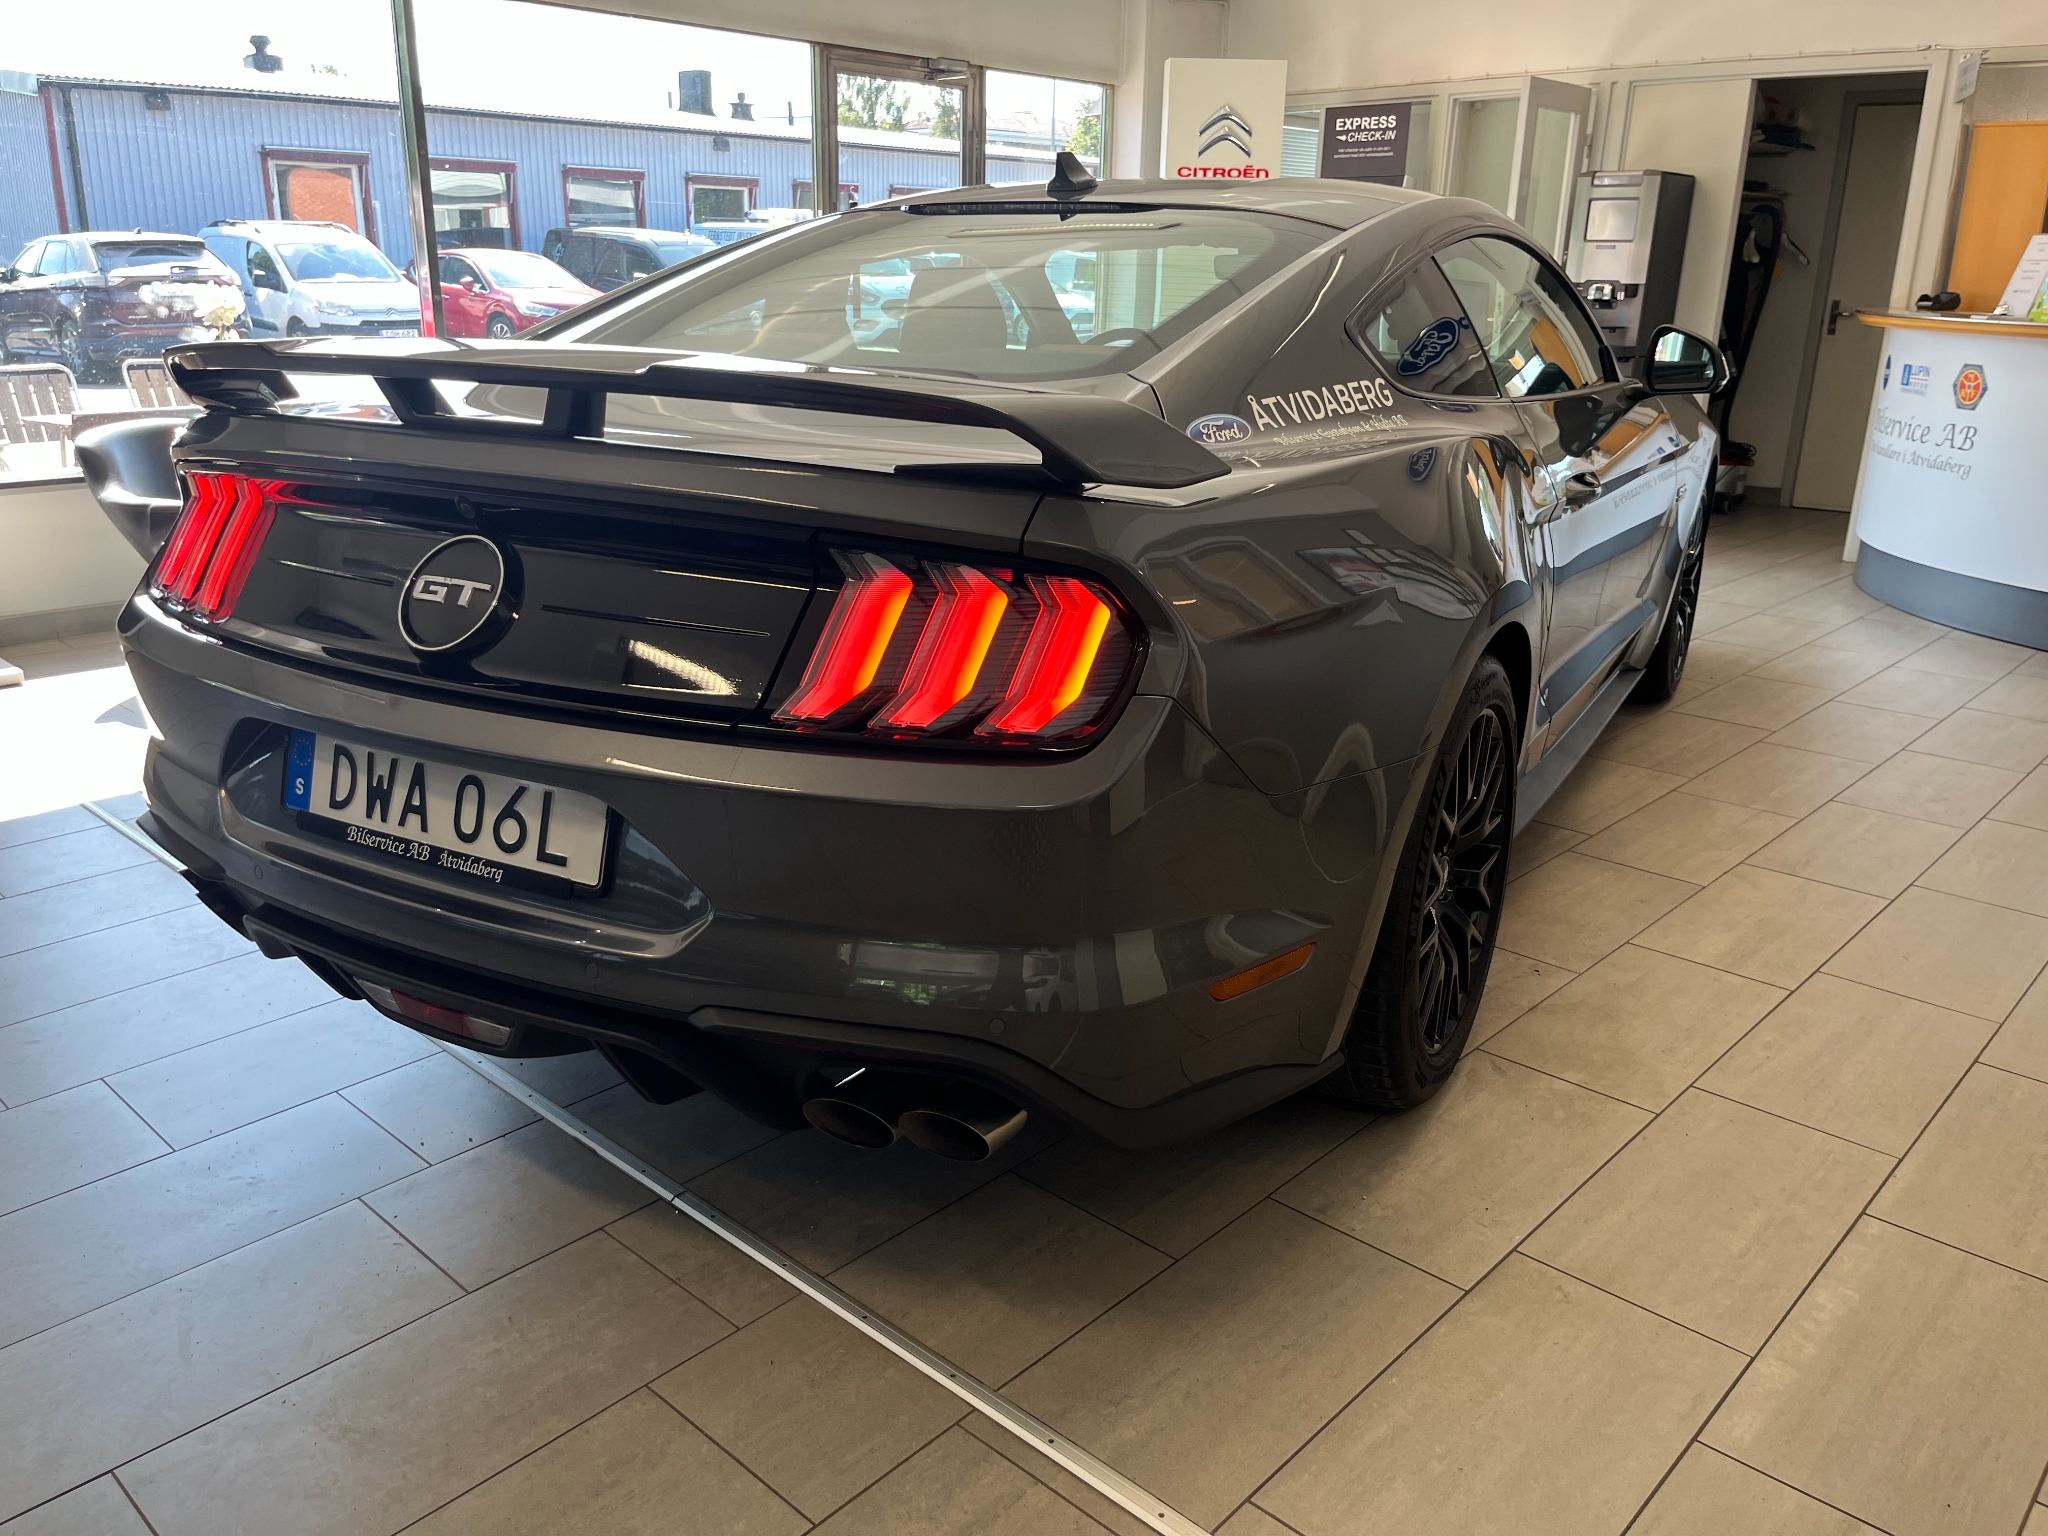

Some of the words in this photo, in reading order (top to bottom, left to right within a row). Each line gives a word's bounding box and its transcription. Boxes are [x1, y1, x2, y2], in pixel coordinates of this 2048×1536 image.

[1335, 115, 1397, 131] EXPRESS
[1347, 129, 1397, 143] CHECK-IN
[1177, 164, 1270, 179] CITROËN
[1247, 377, 1394, 432] ÅTVIDABERG
[1200, 418, 1244, 443] Ford
[1935, 422, 1978, 452] AB
[412, 574, 494, 609] GT
[294, 777, 306, 796] S
[328, 742, 430, 834] DWA
[453, 773, 569, 869] 06L
[347, 825, 405, 857] Bilservice
[406, 842, 431, 862] AB
[437, 849, 504, 883] Åtvidaberg
[1409, 770, 1447, 938] MICHELIN
